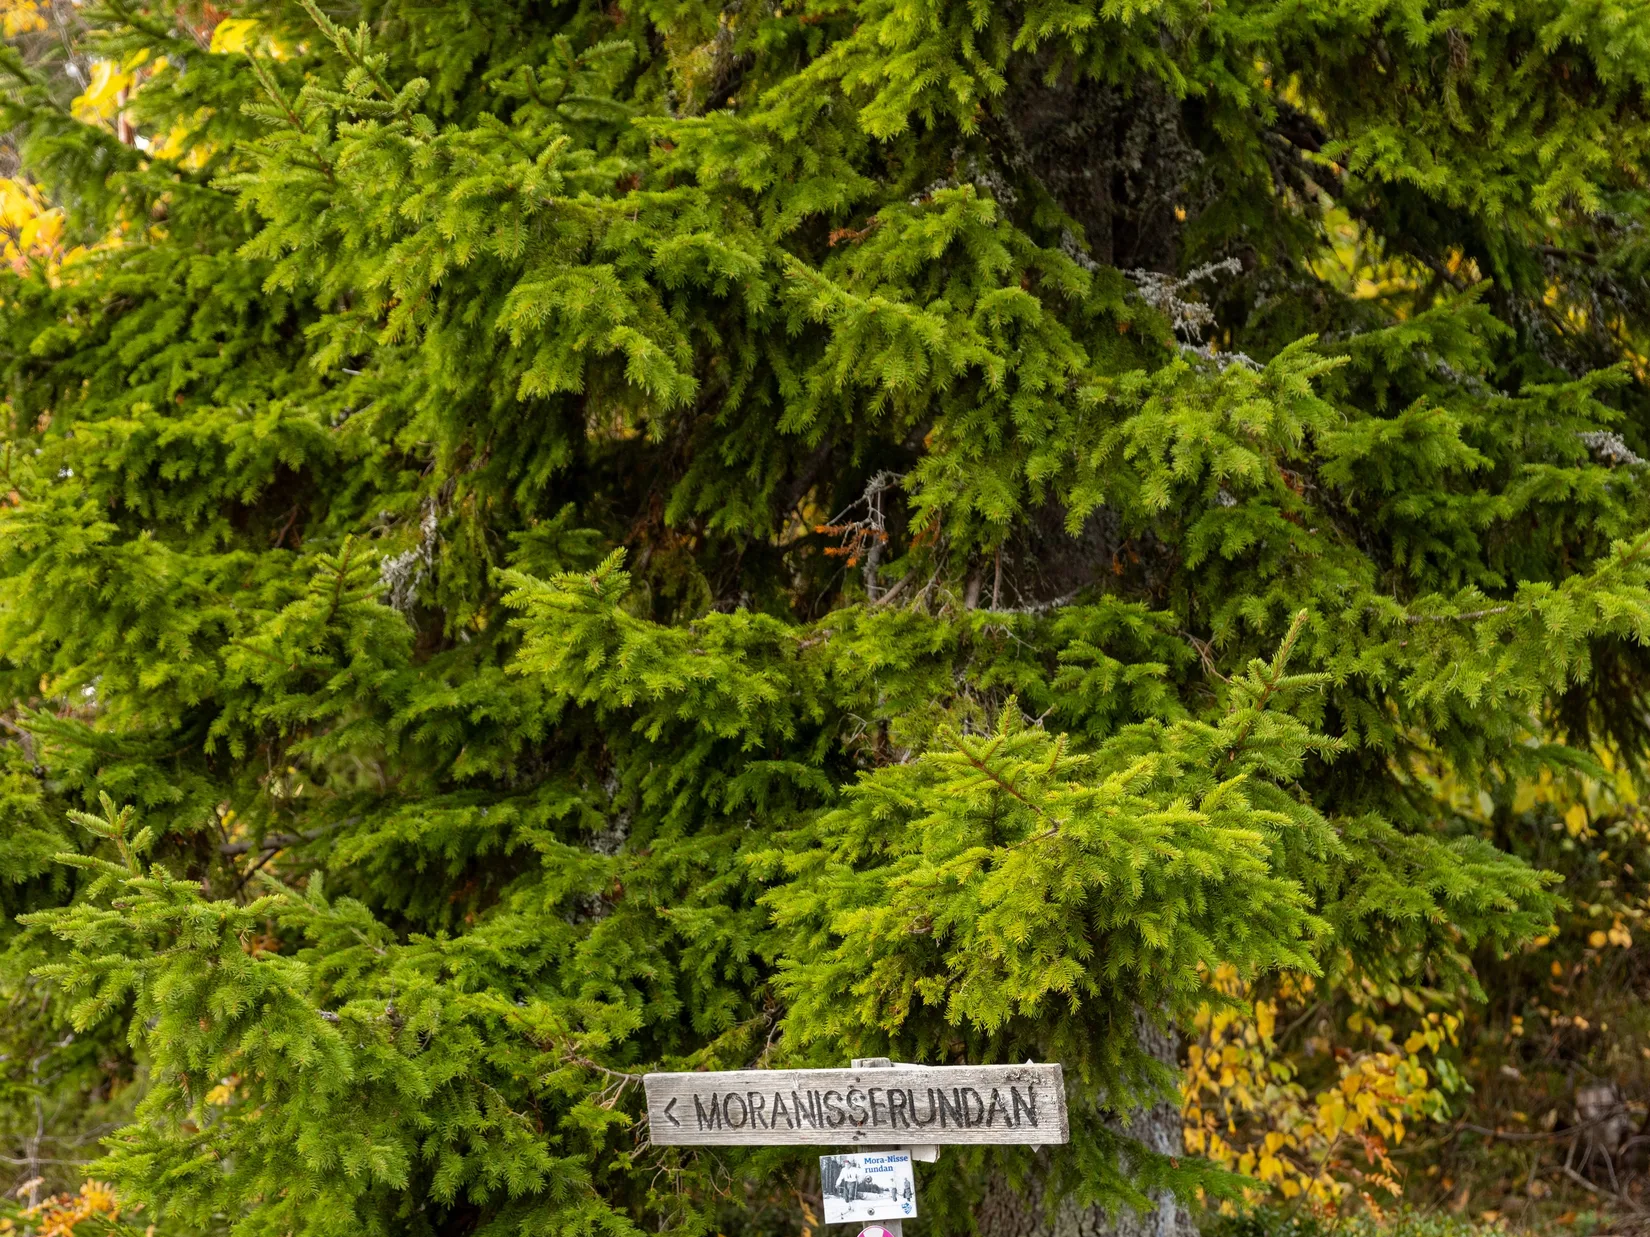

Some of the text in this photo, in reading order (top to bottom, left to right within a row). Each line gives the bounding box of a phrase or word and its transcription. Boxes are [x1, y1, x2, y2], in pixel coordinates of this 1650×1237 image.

[693, 1085, 1039, 1131] MORANISSERUNDAN
[864, 1155, 908, 1165] Mora-Nisse
[865, 1165, 894, 1173] rundan
